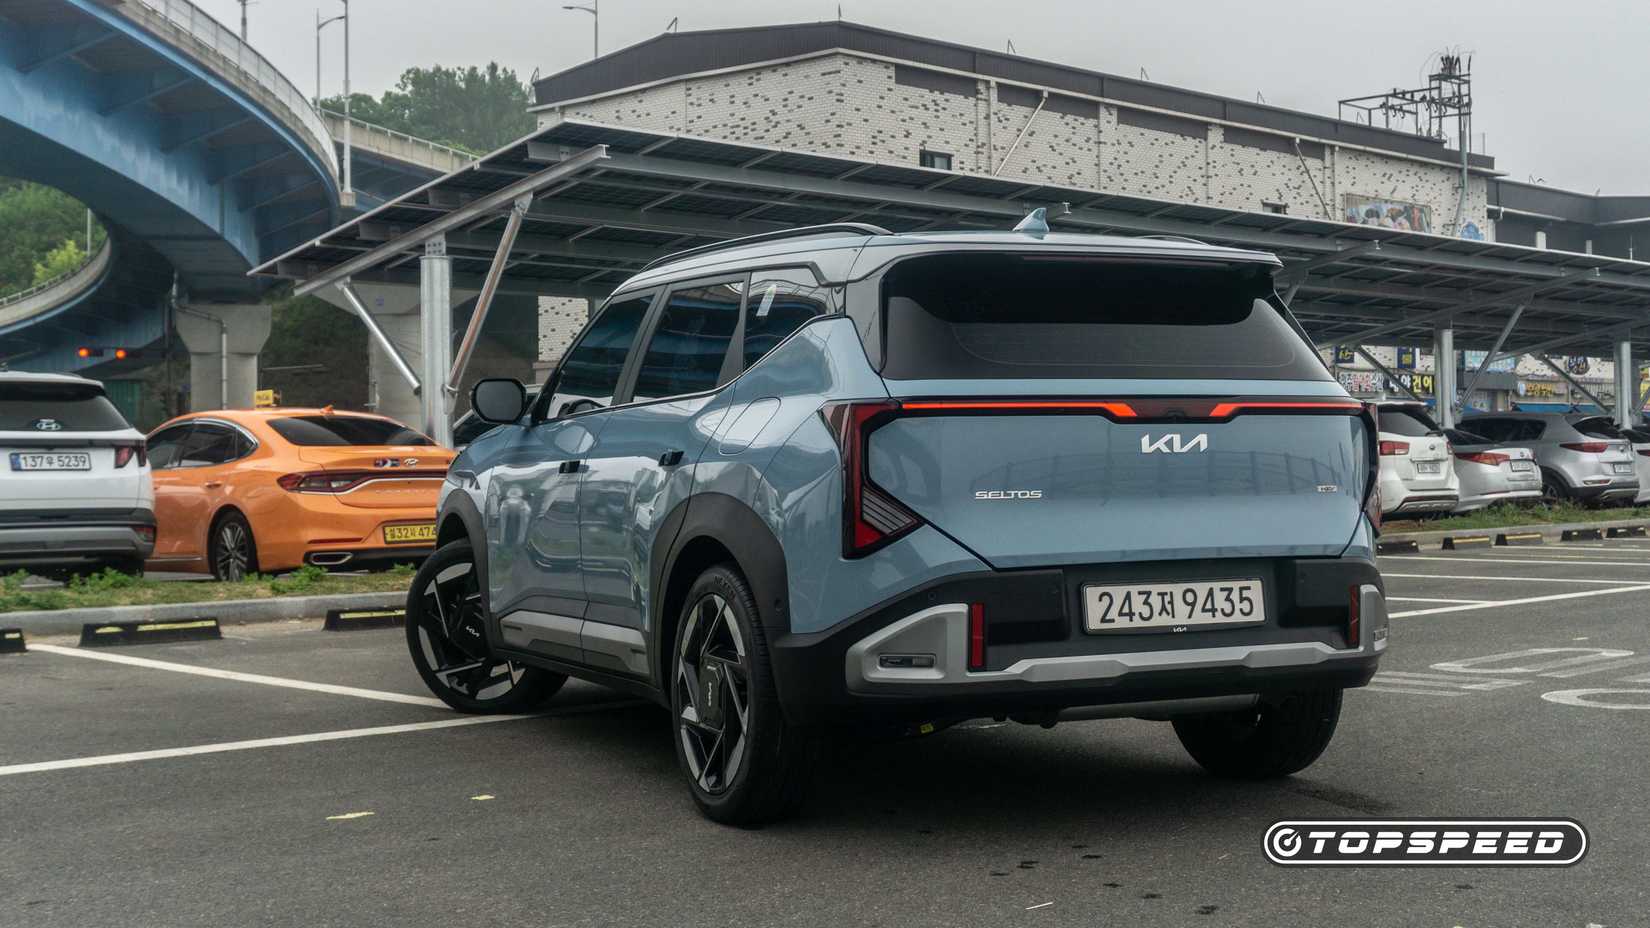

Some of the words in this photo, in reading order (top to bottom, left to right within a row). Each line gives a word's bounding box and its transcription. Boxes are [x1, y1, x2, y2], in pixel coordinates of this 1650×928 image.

[1140, 433, 1208, 453] KIA
[975, 490, 1042, 499] SELTOS
[1098, 590, 1175, 624] 243저
[1182, 586, 1254, 620] 9435
